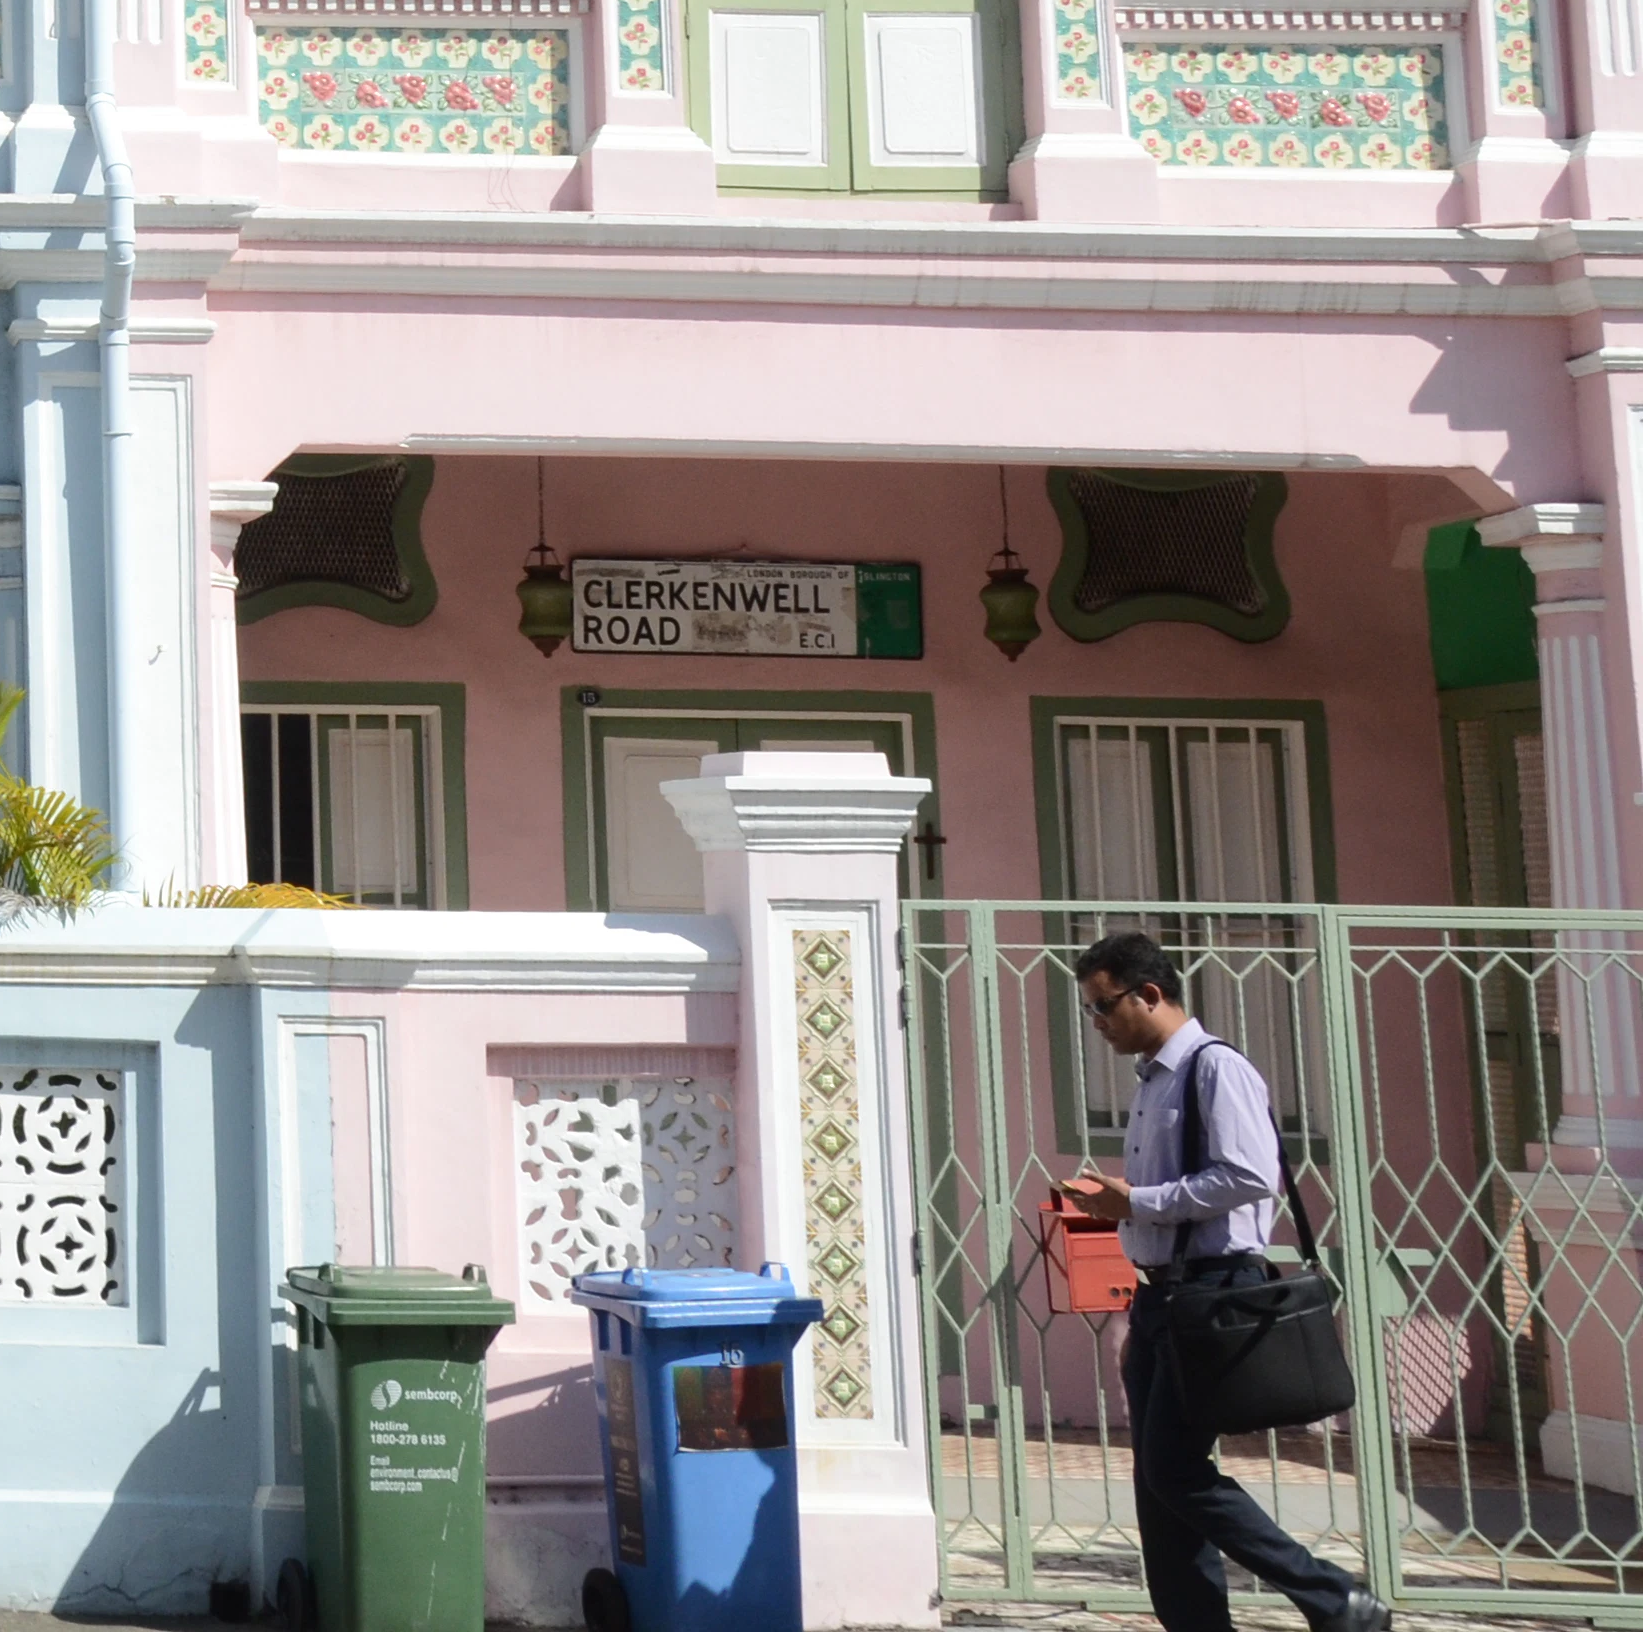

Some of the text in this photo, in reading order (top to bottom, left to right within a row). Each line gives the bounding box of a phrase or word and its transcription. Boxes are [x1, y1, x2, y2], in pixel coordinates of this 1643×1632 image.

[747, 569, 783, 578] LONDON
[790, 570, 832, 579] BOROUGH
[838, 571, 849, 579] OF
[583, 579, 831, 614] CLERKENWELL
[583, 615, 681, 646] ROAD
[582, 692, 596, 703] 15
[405, 1387, 458, 1404] sembcorp
[370, 1421, 409, 1431] Hotline
[370, 1434, 446, 1445] 1800-278 6135
[370, 1455, 390, 1466] Email
[370, 1480, 422, 1494] sembcorp.com
